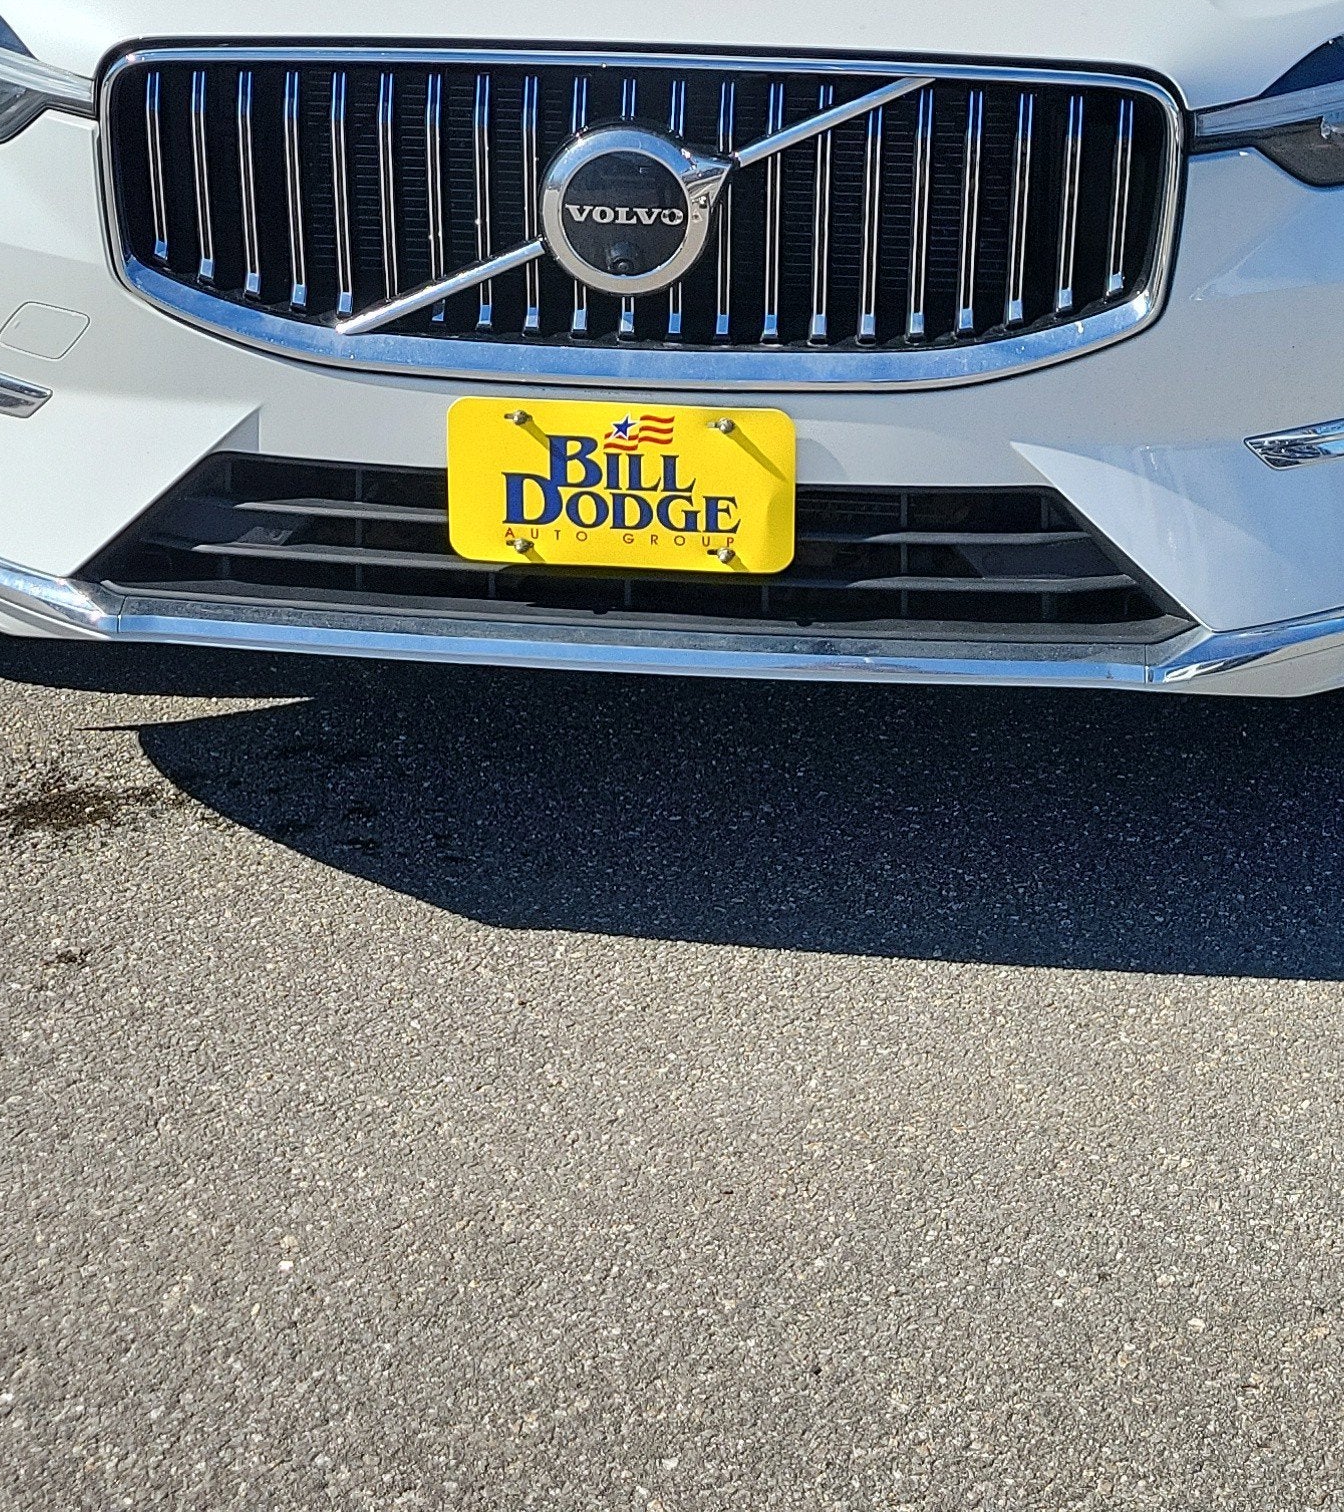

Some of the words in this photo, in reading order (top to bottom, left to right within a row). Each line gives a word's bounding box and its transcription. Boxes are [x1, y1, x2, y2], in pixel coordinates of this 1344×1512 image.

[564, 203, 684, 226] VOLVO
[546, 433, 697, 494] BILL
[500, 471, 742, 535] DODGE
[503, 526, 589, 542] AUTO
[621, 532, 736, 548] GROUP
